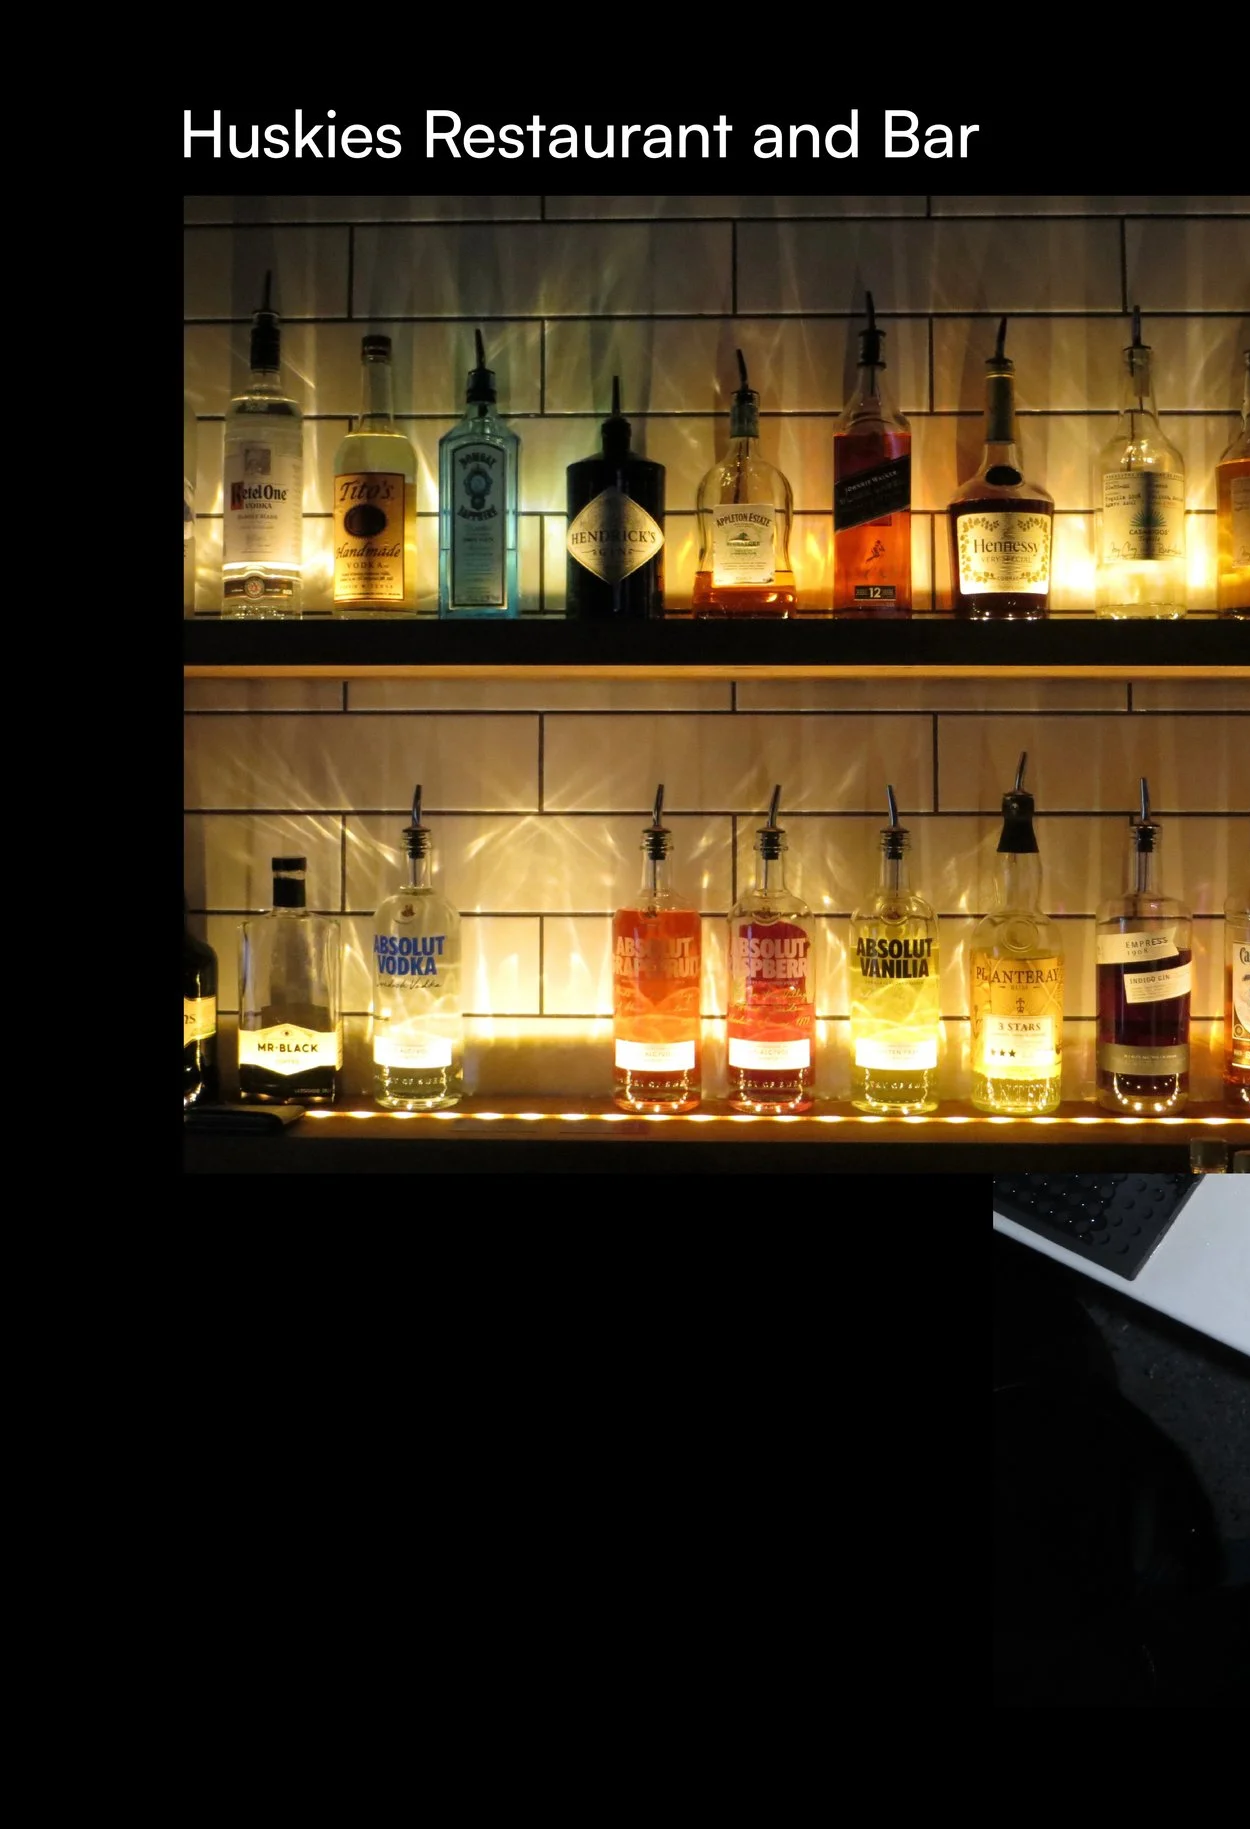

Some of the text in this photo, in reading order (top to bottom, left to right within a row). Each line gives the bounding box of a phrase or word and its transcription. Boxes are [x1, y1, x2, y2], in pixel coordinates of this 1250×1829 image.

[459, 453, 497, 470] BOMBAY
[264, 484, 287, 500] One
[340, 480, 394, 501] Tito's
[716, 513, 749, 528] APPLETON
[336, 542, 401, 559] Handmade
[974, 538, 1038, 557] Hennessy
[869, 587, 881, 598] 12
[373, 935, 446, 956] ABSOLUT
[856, 936, 933, 959] ABSOLUT
[1125, 936, 1169, 949] EMPRESS
[377, 955, 437, 976] VODKA
[860, 957, 930, 979] VANILIA
[976, 966, 1059, 984] PLANTERAY
[1129, 974, 1170, 985] INDIGO GIN
[999, 1022, 1041, 1032] 3 STARS
